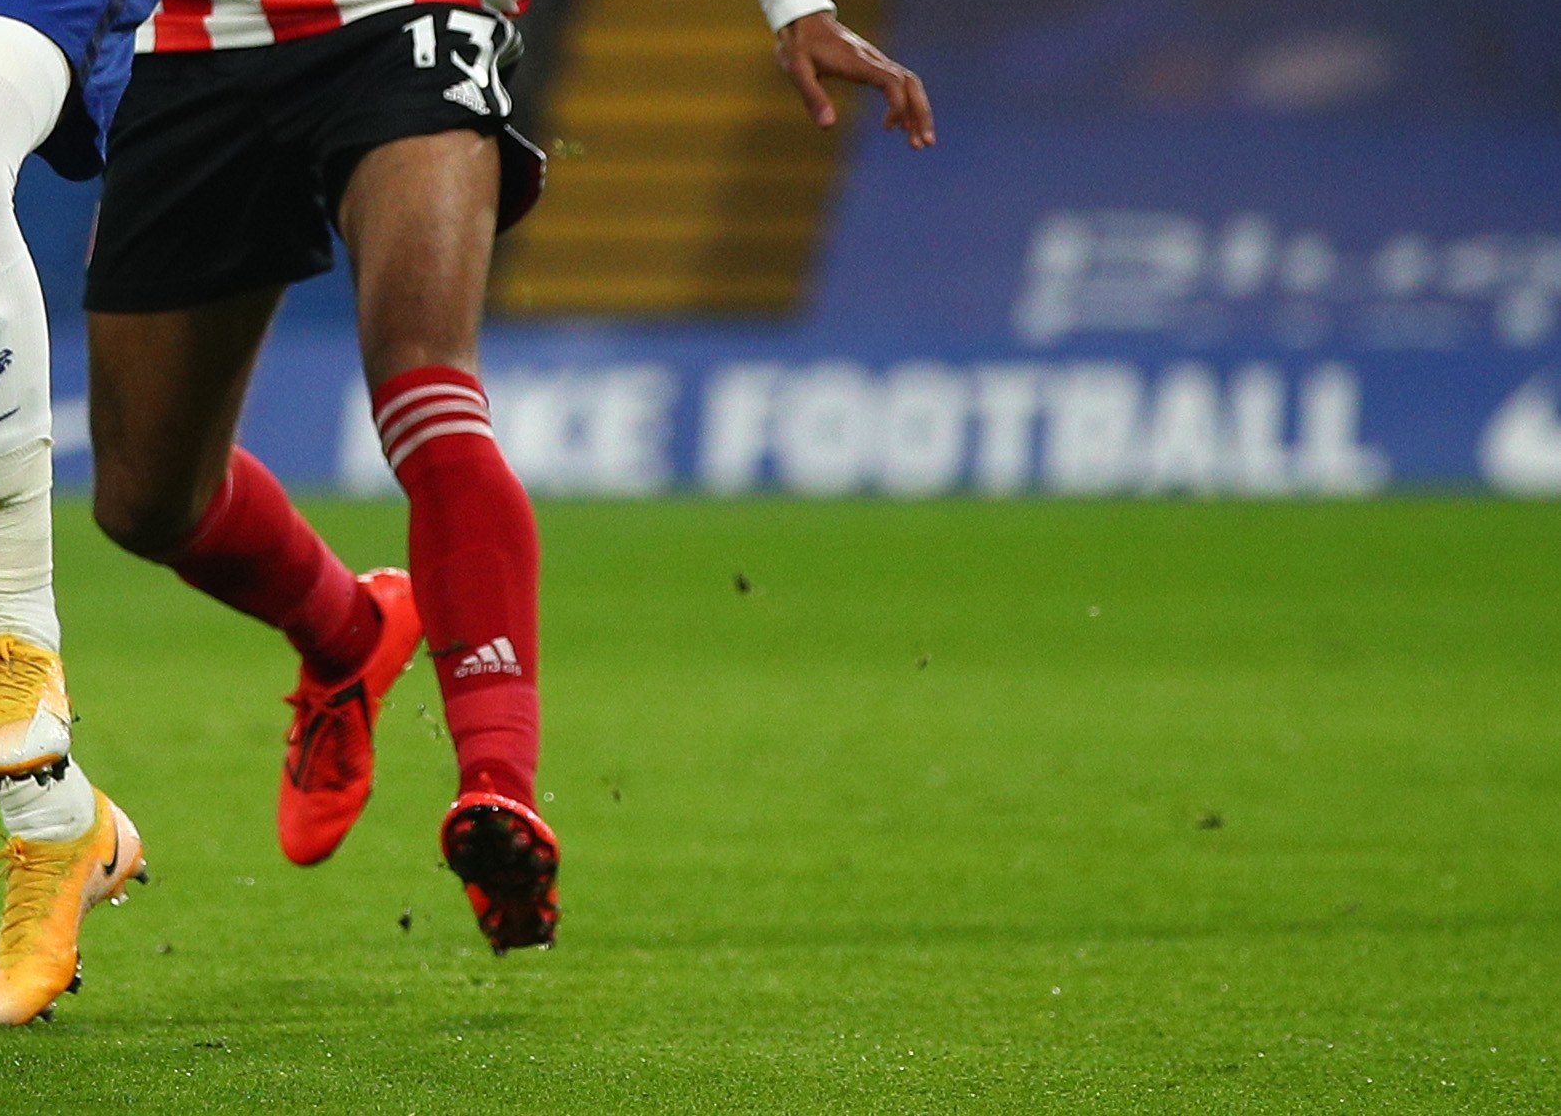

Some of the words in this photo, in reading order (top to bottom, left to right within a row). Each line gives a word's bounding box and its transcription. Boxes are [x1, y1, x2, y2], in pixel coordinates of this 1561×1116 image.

[402, 10, 497, 88] 13
[699, 362, 1389, 496] FOOTBALL
[454, 661, 522, 678] adidas
